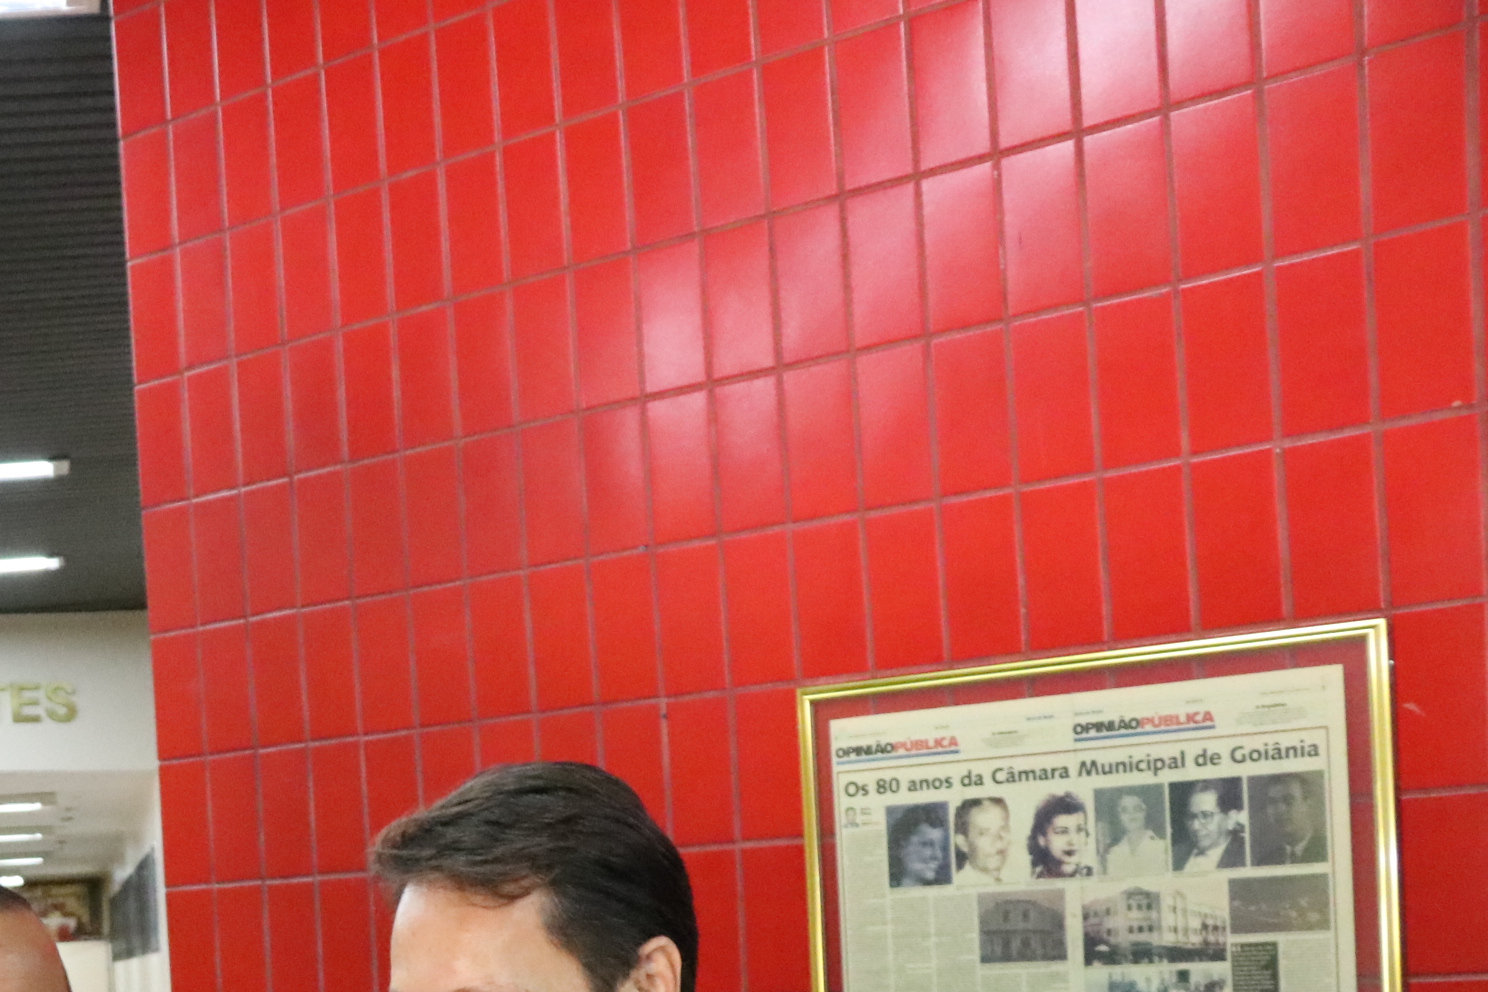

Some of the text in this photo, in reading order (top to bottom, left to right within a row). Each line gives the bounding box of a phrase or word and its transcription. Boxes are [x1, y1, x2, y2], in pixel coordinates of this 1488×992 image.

[844, 739, 1320, 798] Os 80 anos da Câmara Municipal de Goiânia
